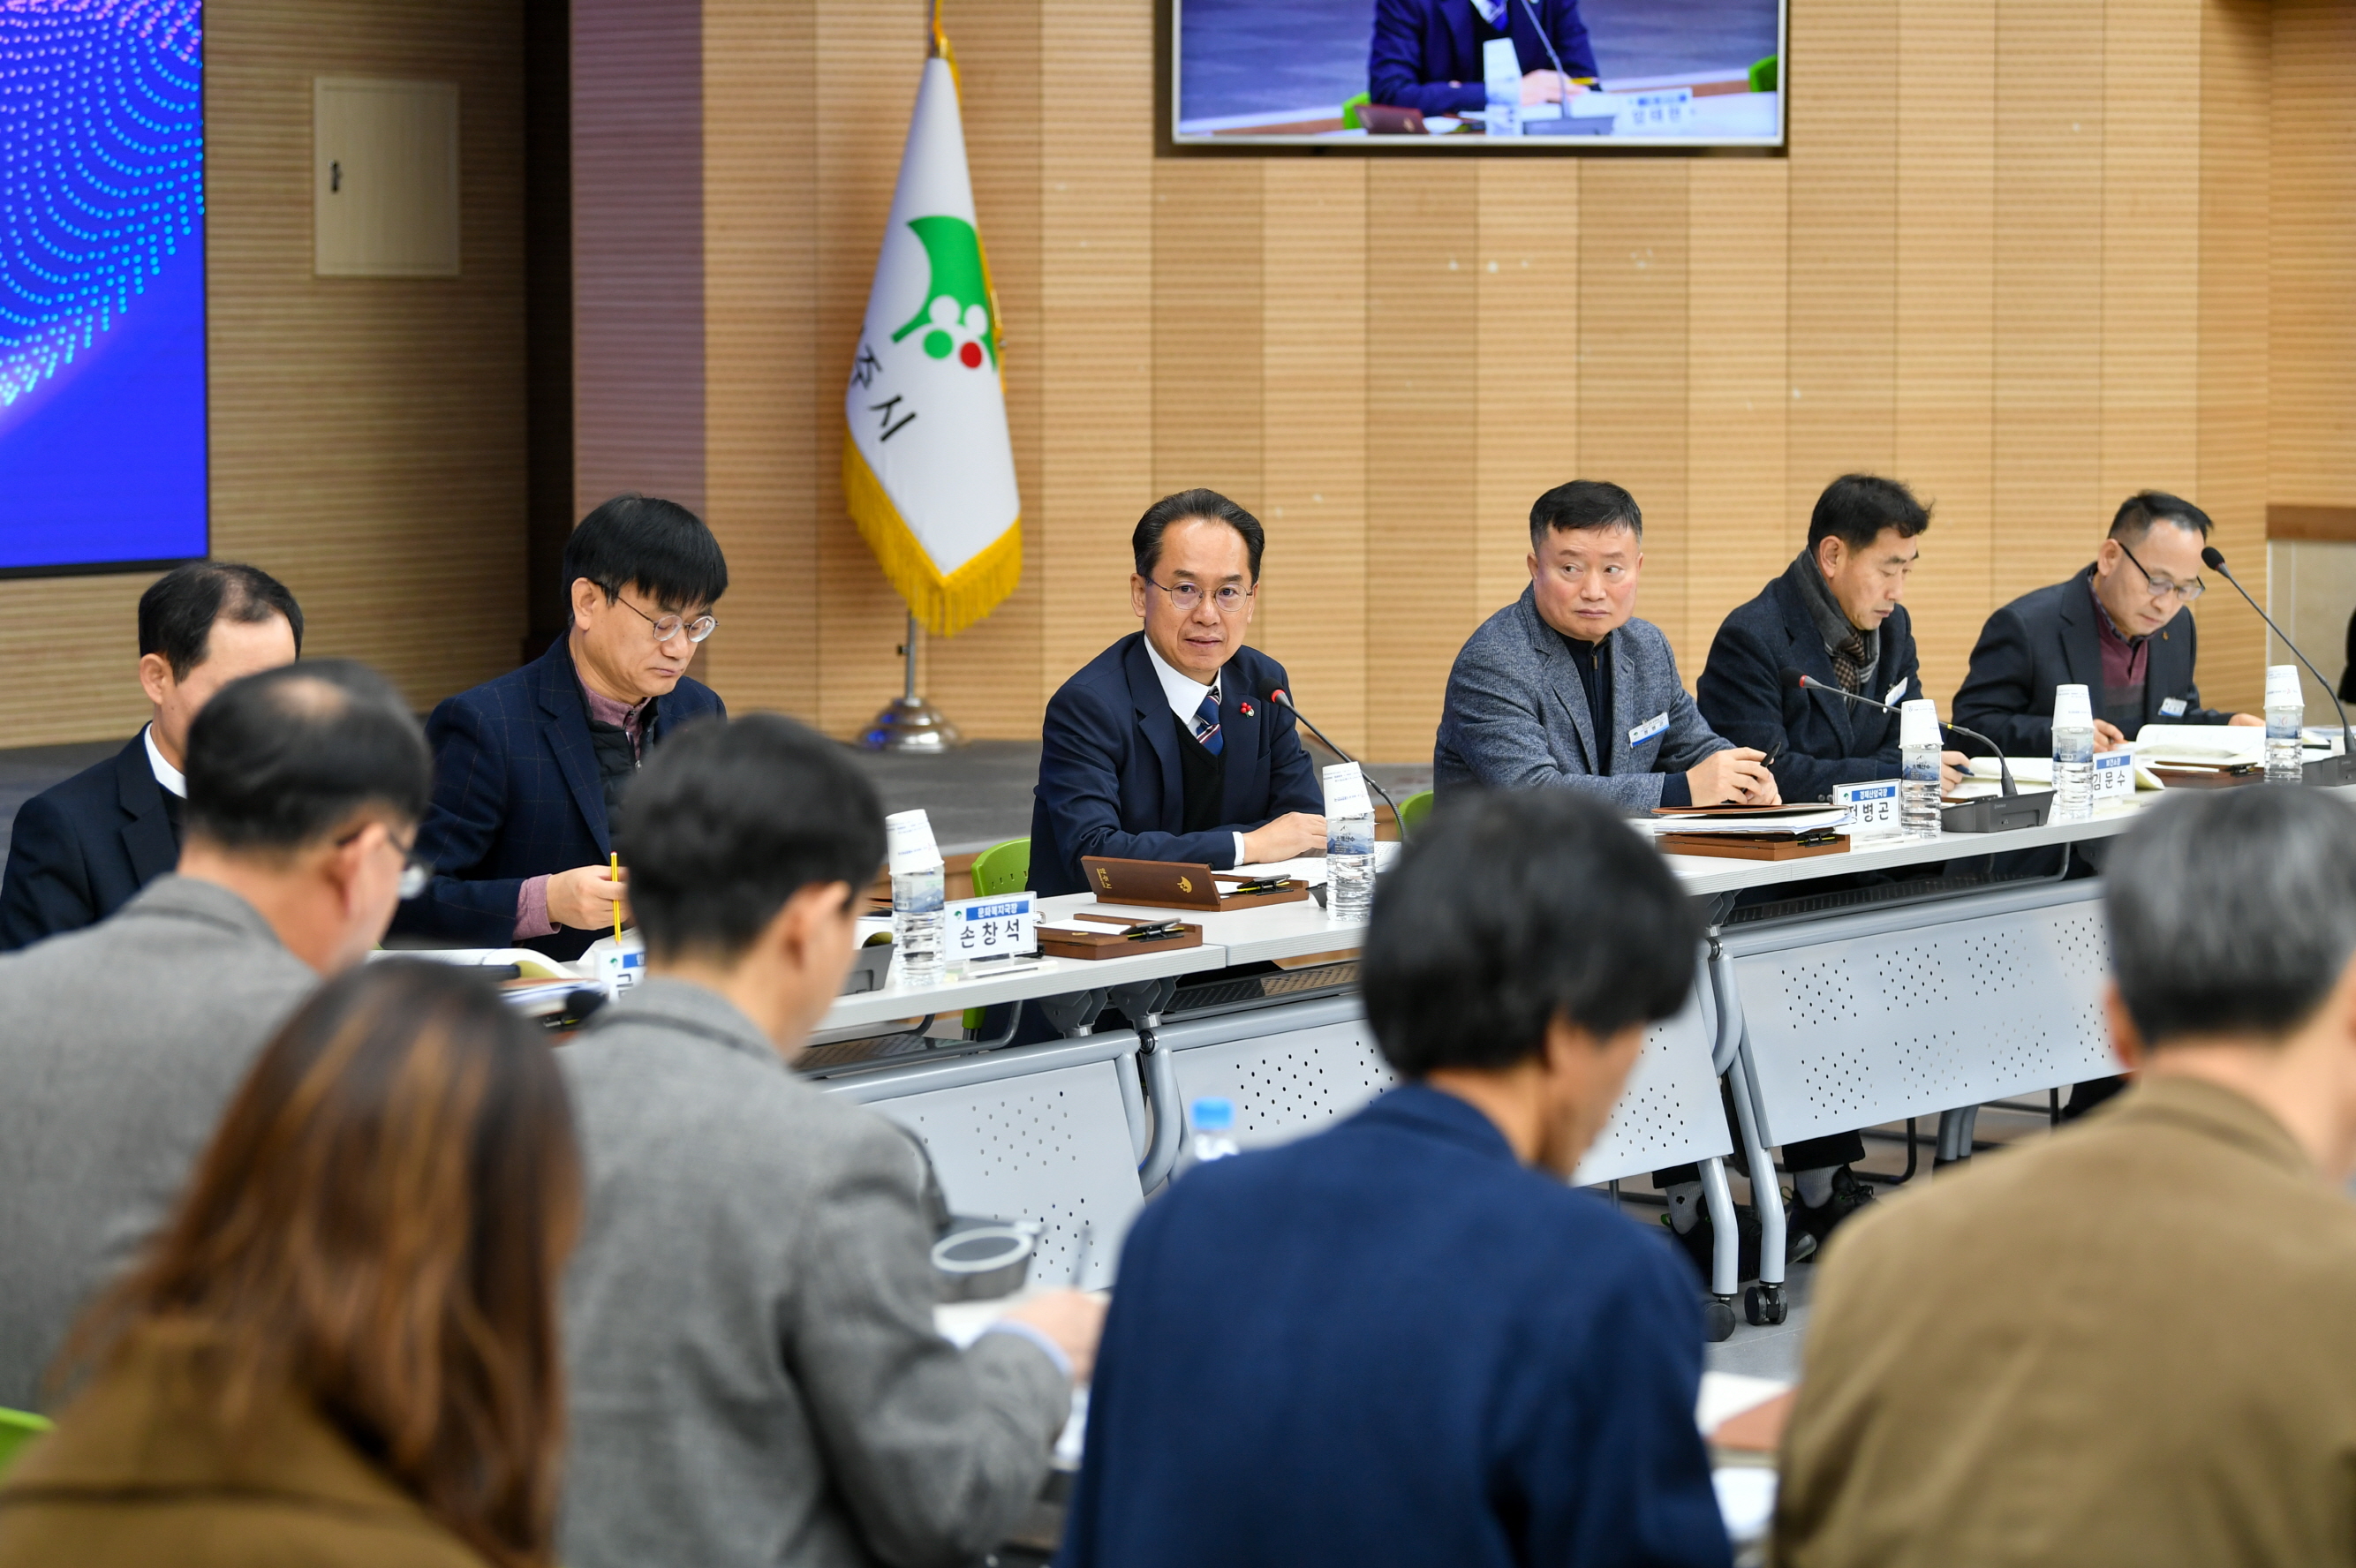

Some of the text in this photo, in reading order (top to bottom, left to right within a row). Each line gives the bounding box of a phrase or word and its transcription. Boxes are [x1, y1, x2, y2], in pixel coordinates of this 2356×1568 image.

[850, 343, 917, 442] 주시
[2093, 770, 2126, 791] 김문수
[1859, 788, 1888, 800] 경제산업국장
[977, 902, 1018, 918] 문화복지국장
[960, 918, 1020, 949] 손창석
